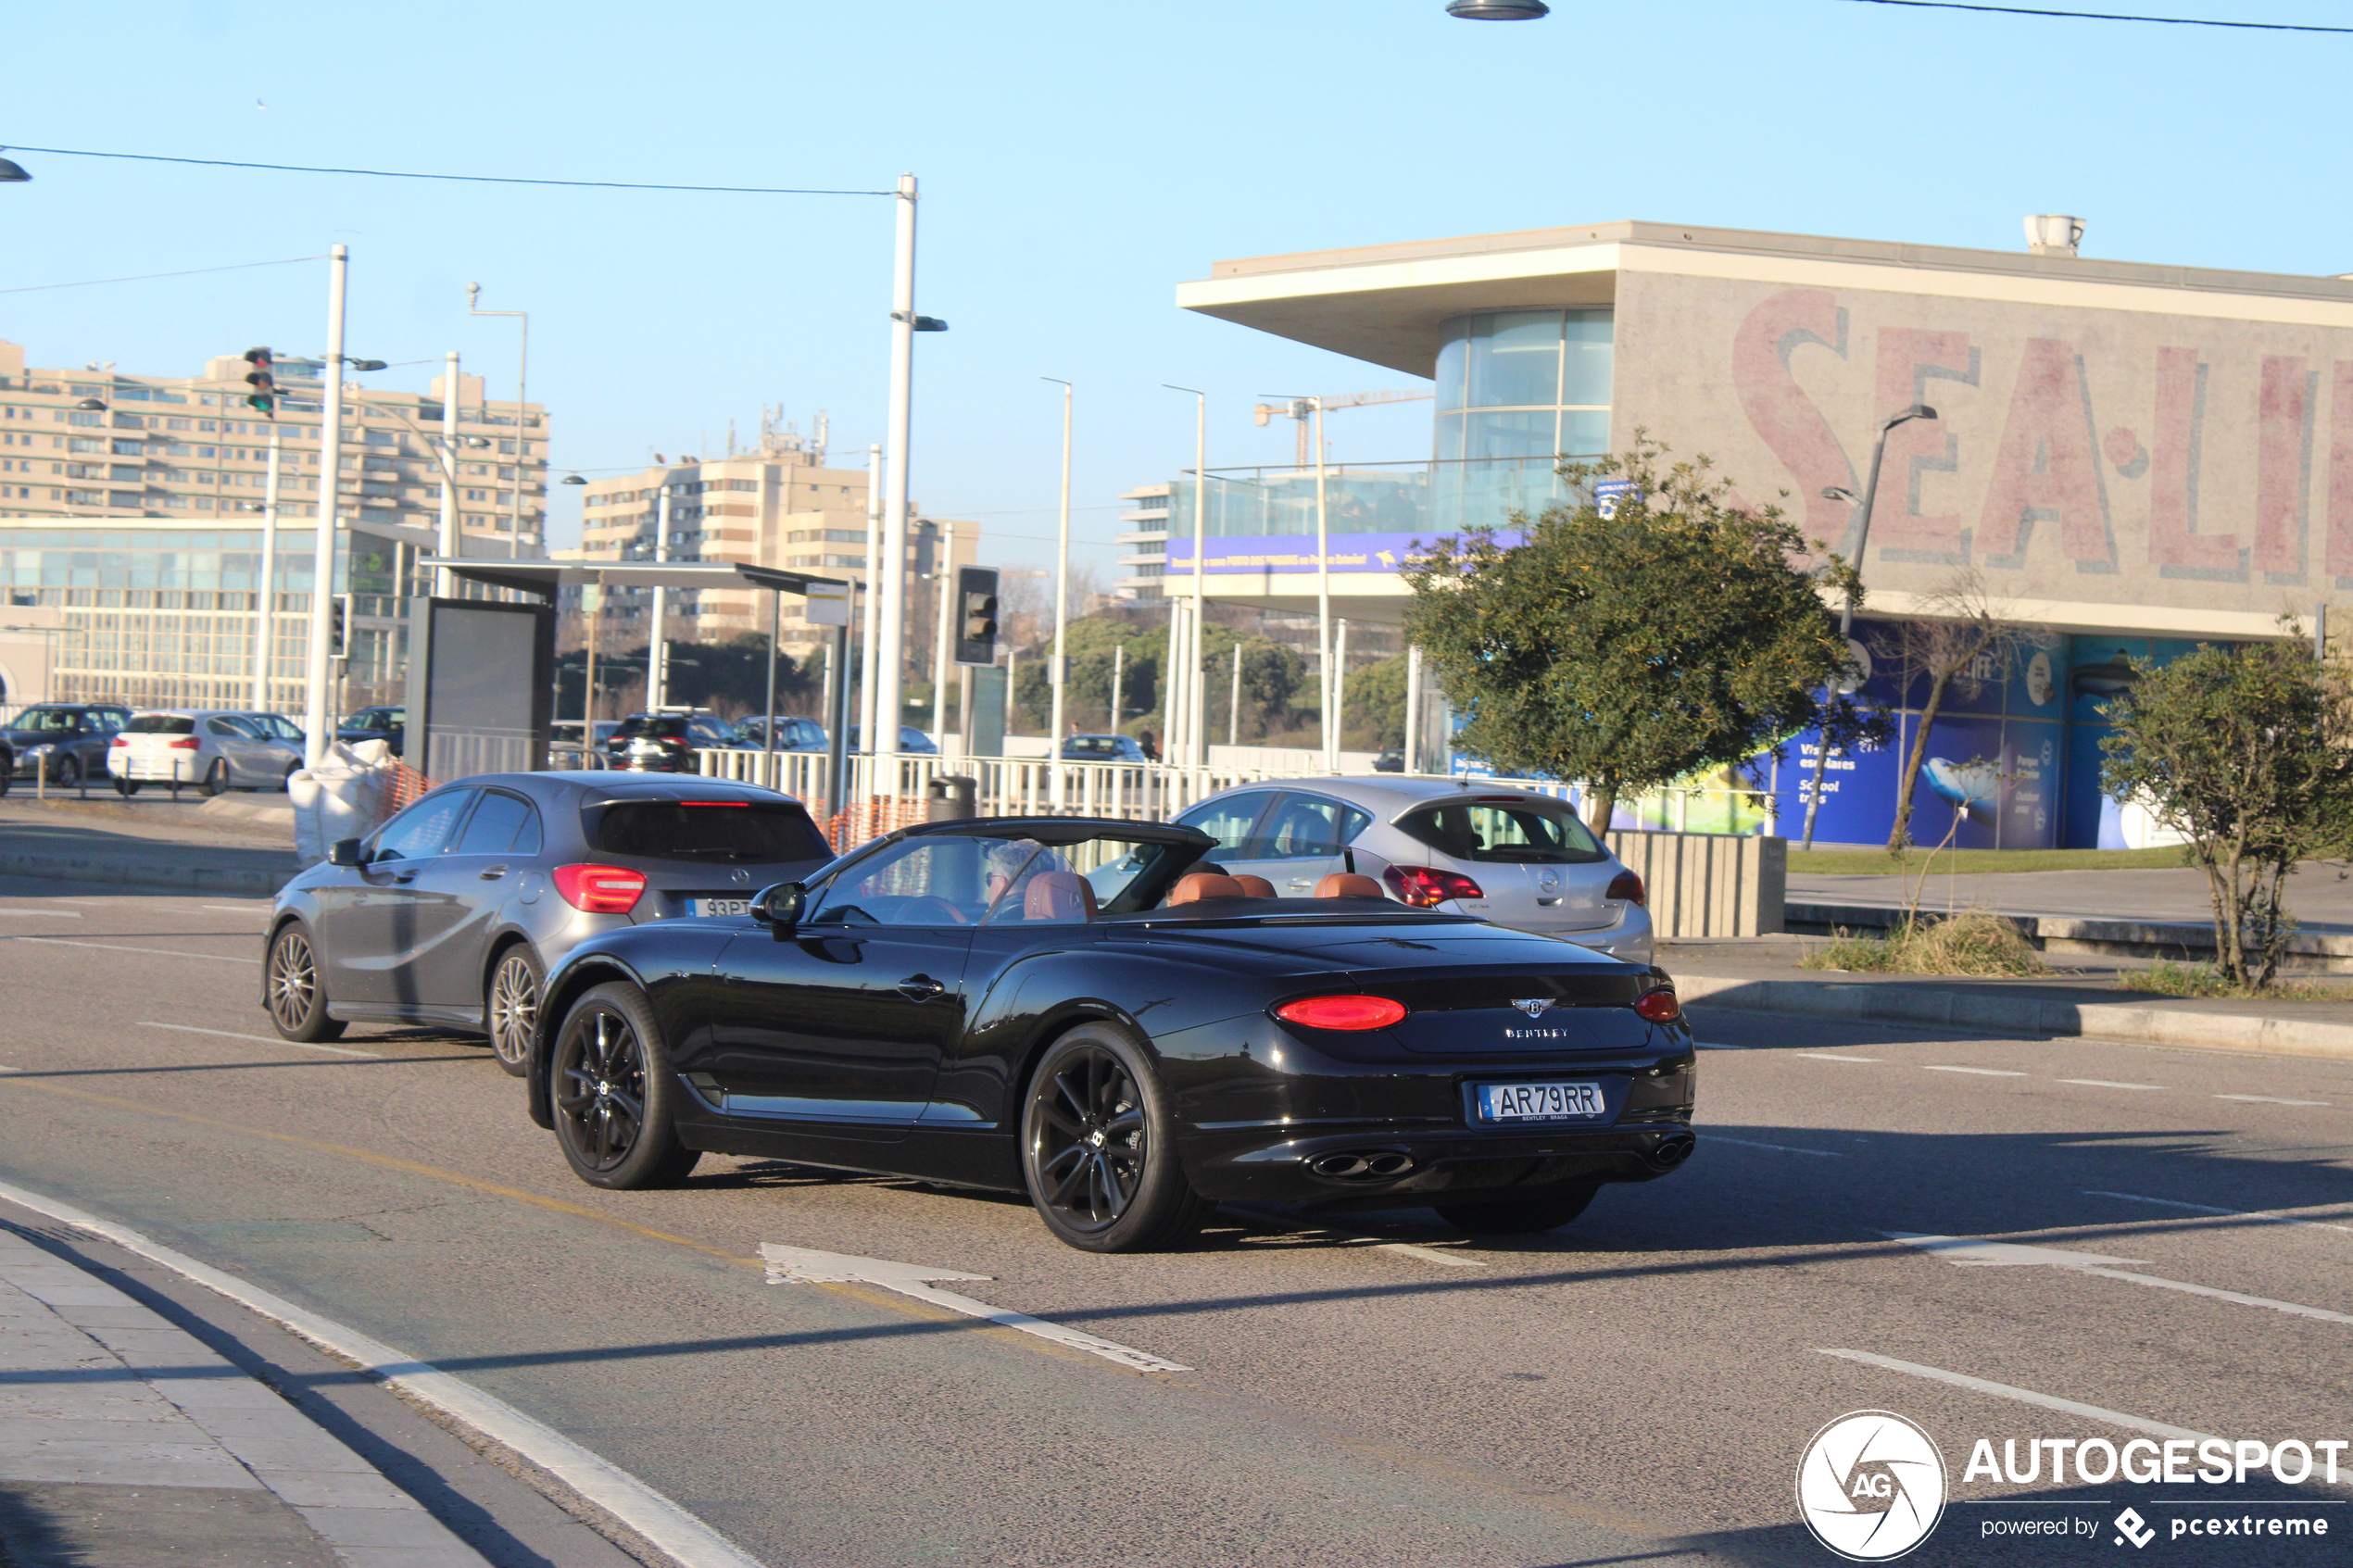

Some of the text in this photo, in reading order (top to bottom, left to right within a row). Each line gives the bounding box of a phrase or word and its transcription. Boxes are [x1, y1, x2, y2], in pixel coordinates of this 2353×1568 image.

[1799, 779, 1840, 792] Scool
[1506, 1028, 1568, 1038] BENTLEY
[1500, 1085, 1596, 1115] AR79RR
